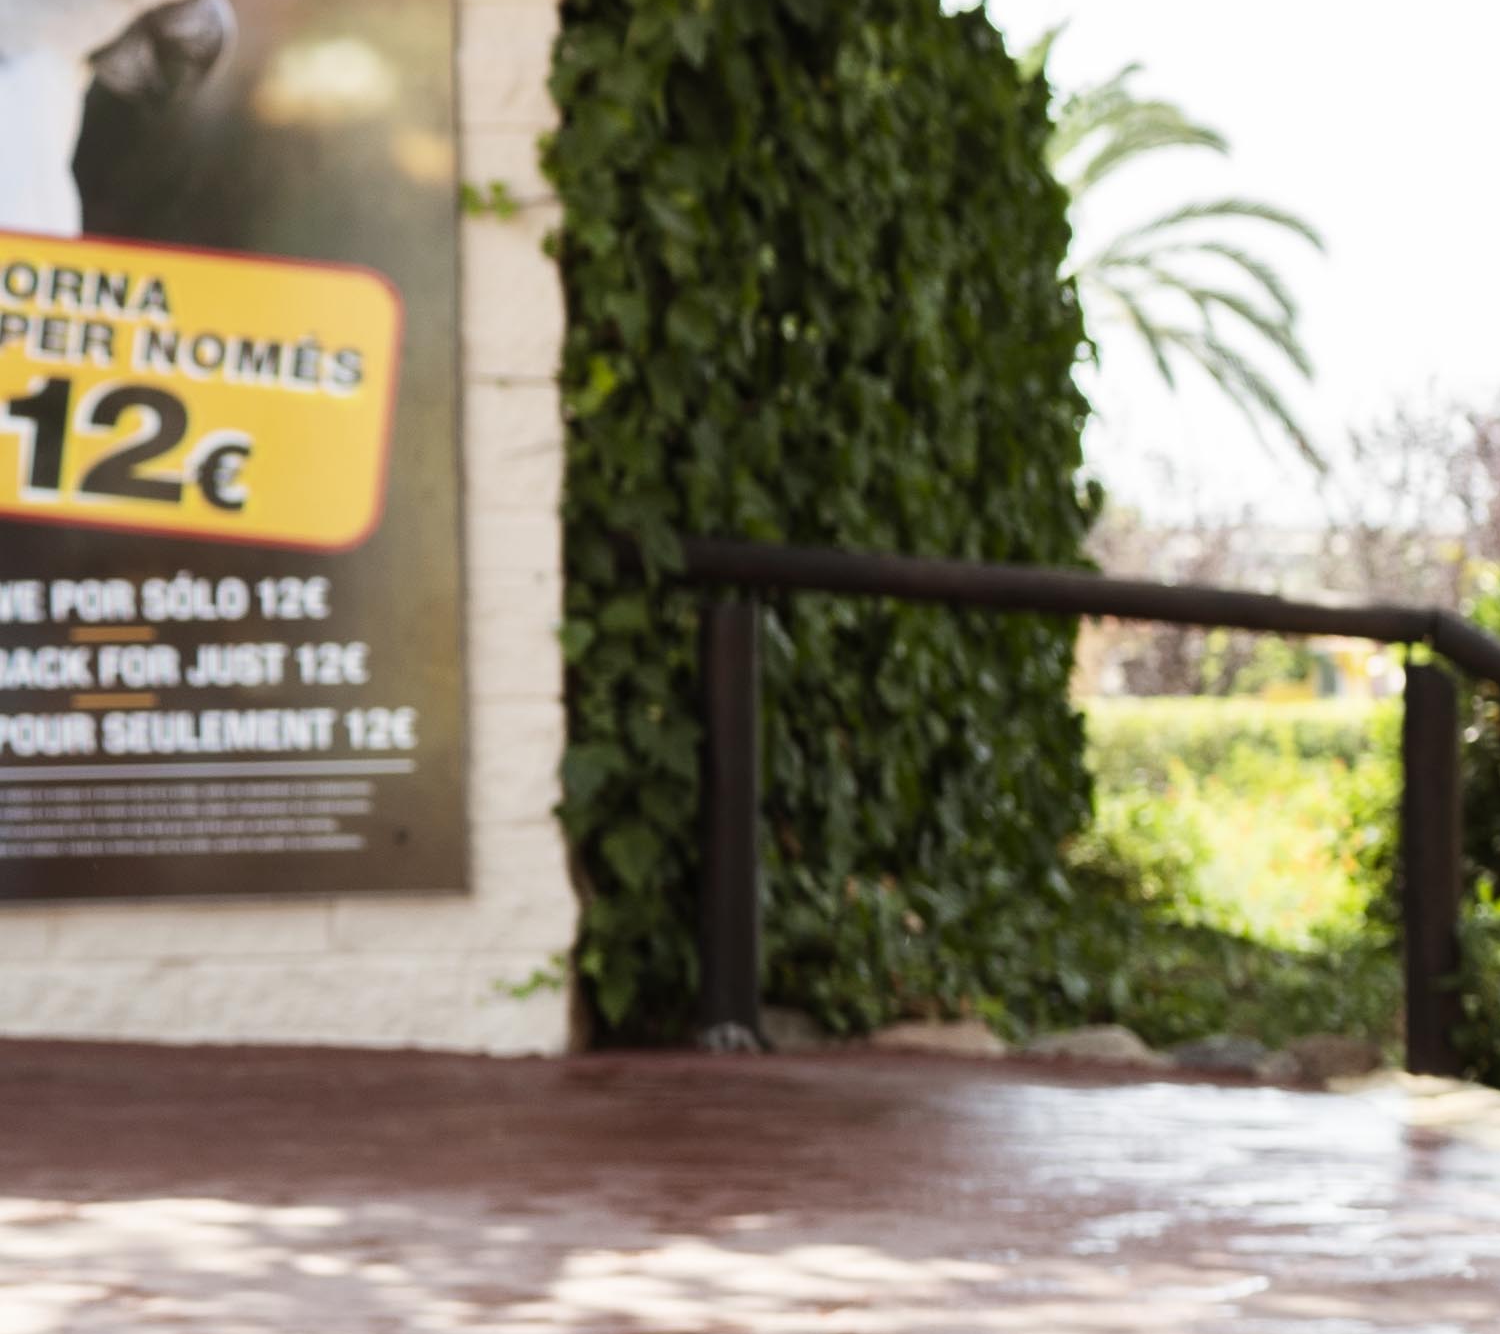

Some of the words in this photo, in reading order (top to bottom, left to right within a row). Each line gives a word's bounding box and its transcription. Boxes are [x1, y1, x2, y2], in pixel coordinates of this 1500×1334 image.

[0, 312, 115, 364] PER
[138, 331, 365, 391] NOMÉS
[3, 375, 252, 513] 12€
[50, 578, 136, 623] POR
[141, 569, 250, 623] SÓLO
[257, 575, 331, 621] 12€
[99, 643, 182, 689] FOR
[187, 642, 288, 687] JUST
[296, 640, 371, 686] 12€
[102, 707, 336, 755] SEULEMENT
[344, 706, 419, 751] 12€
